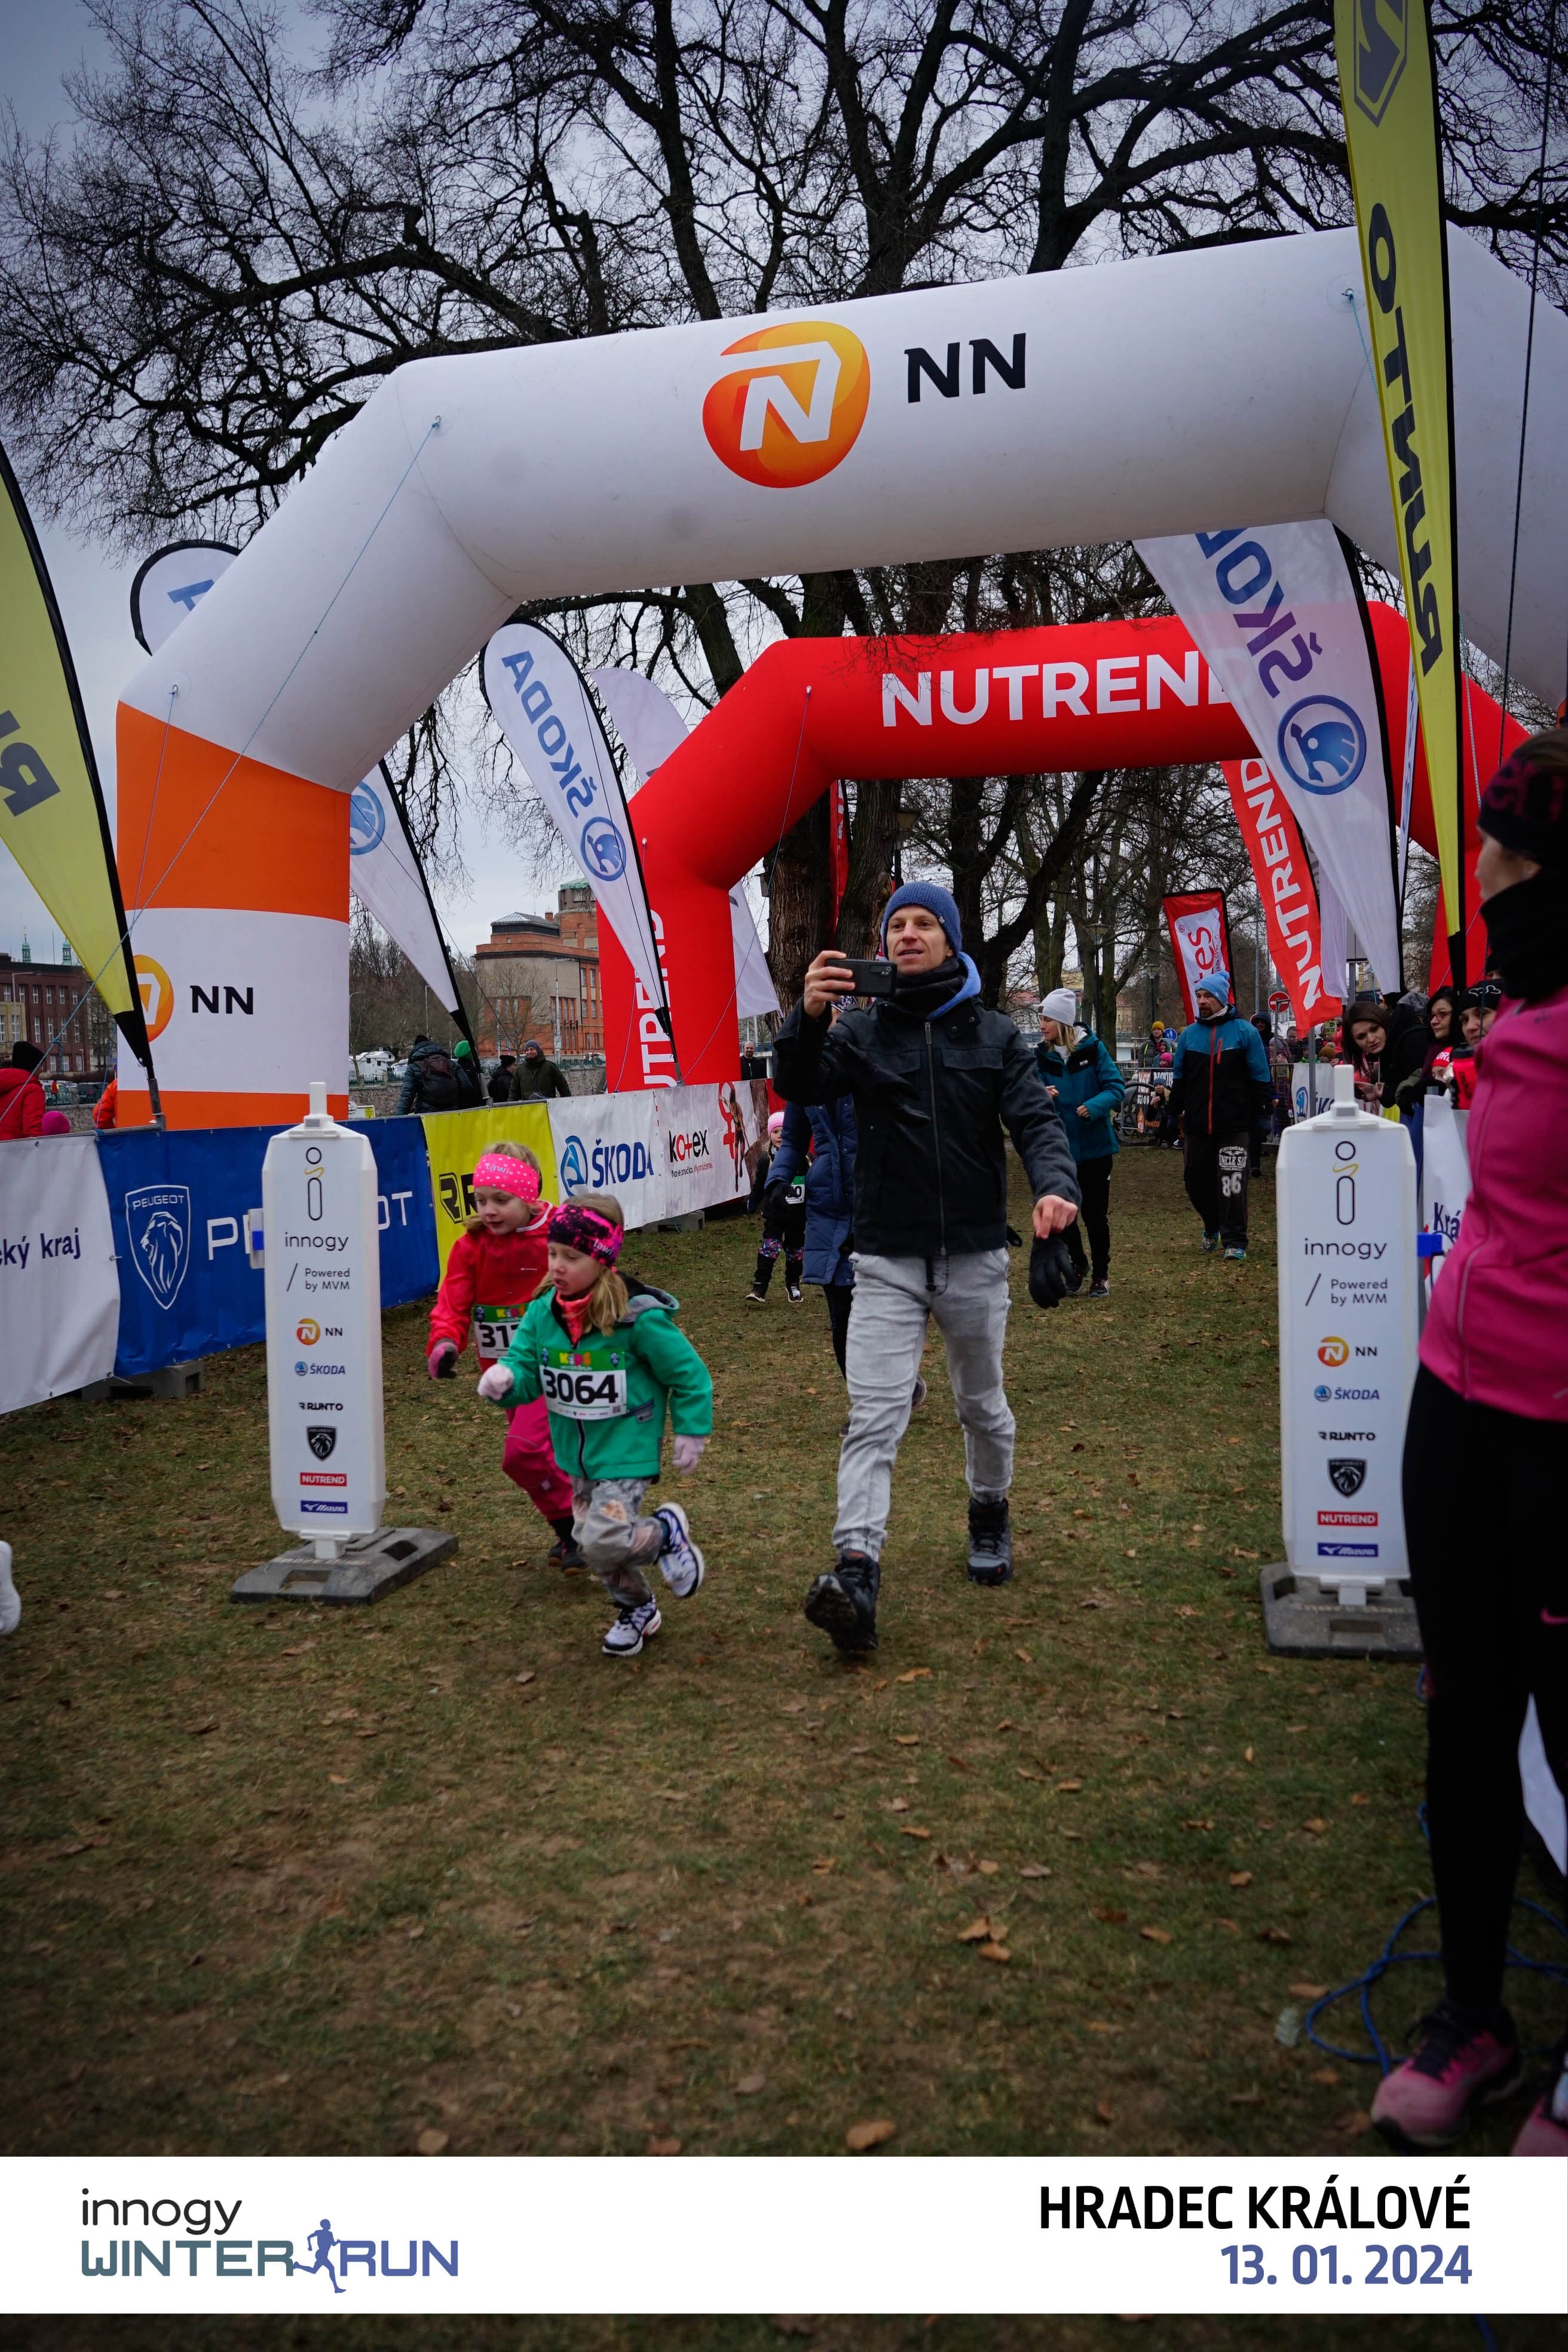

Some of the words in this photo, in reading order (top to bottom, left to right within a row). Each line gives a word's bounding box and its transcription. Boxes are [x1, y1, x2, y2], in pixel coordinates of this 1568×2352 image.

[904, 333, 1027, 403] NN
[1241, 758, 1322, 1010] NUTREND
[191, 985, 254, 1015] NN
[1221, 1172, 1242, 1198] 86
[133, 1195, 185, 1211] PEUGEOT
[284, 1232, 349, 1251] innogy
[0, 1235, 30, 1270] ký
[40, 1227, 81, 1260] kraj
[1304, 1238, 1387, 1260] innogy
[305, 1267, 351, 1278] Powered
[305, 1281, 318, 1293] by
[322, 1281, 350, 1290] MVM
[1331, 1278, 1388, 1289] Powered
[1331, 1294, 1347, 1307] by
[1353, 1294, 1388, 1304] MVM
[325, 1328, 343, 1336] NN
[1355, 1346, 1378, 1356] NN
[310, 1363, 346, 1374] ŠKODA
[543, 1368, 619, 1405] 3064
[1334, 1386, 1380, 1400] ŠKODA
[307, 1402, 344, 1411] RUNTO
[1330, 1432, 1376, 1441] RUNTO
[302, 1475, 345, 1484] NUTREND
[1320, 1514, 1376, 1524] NUTREND
